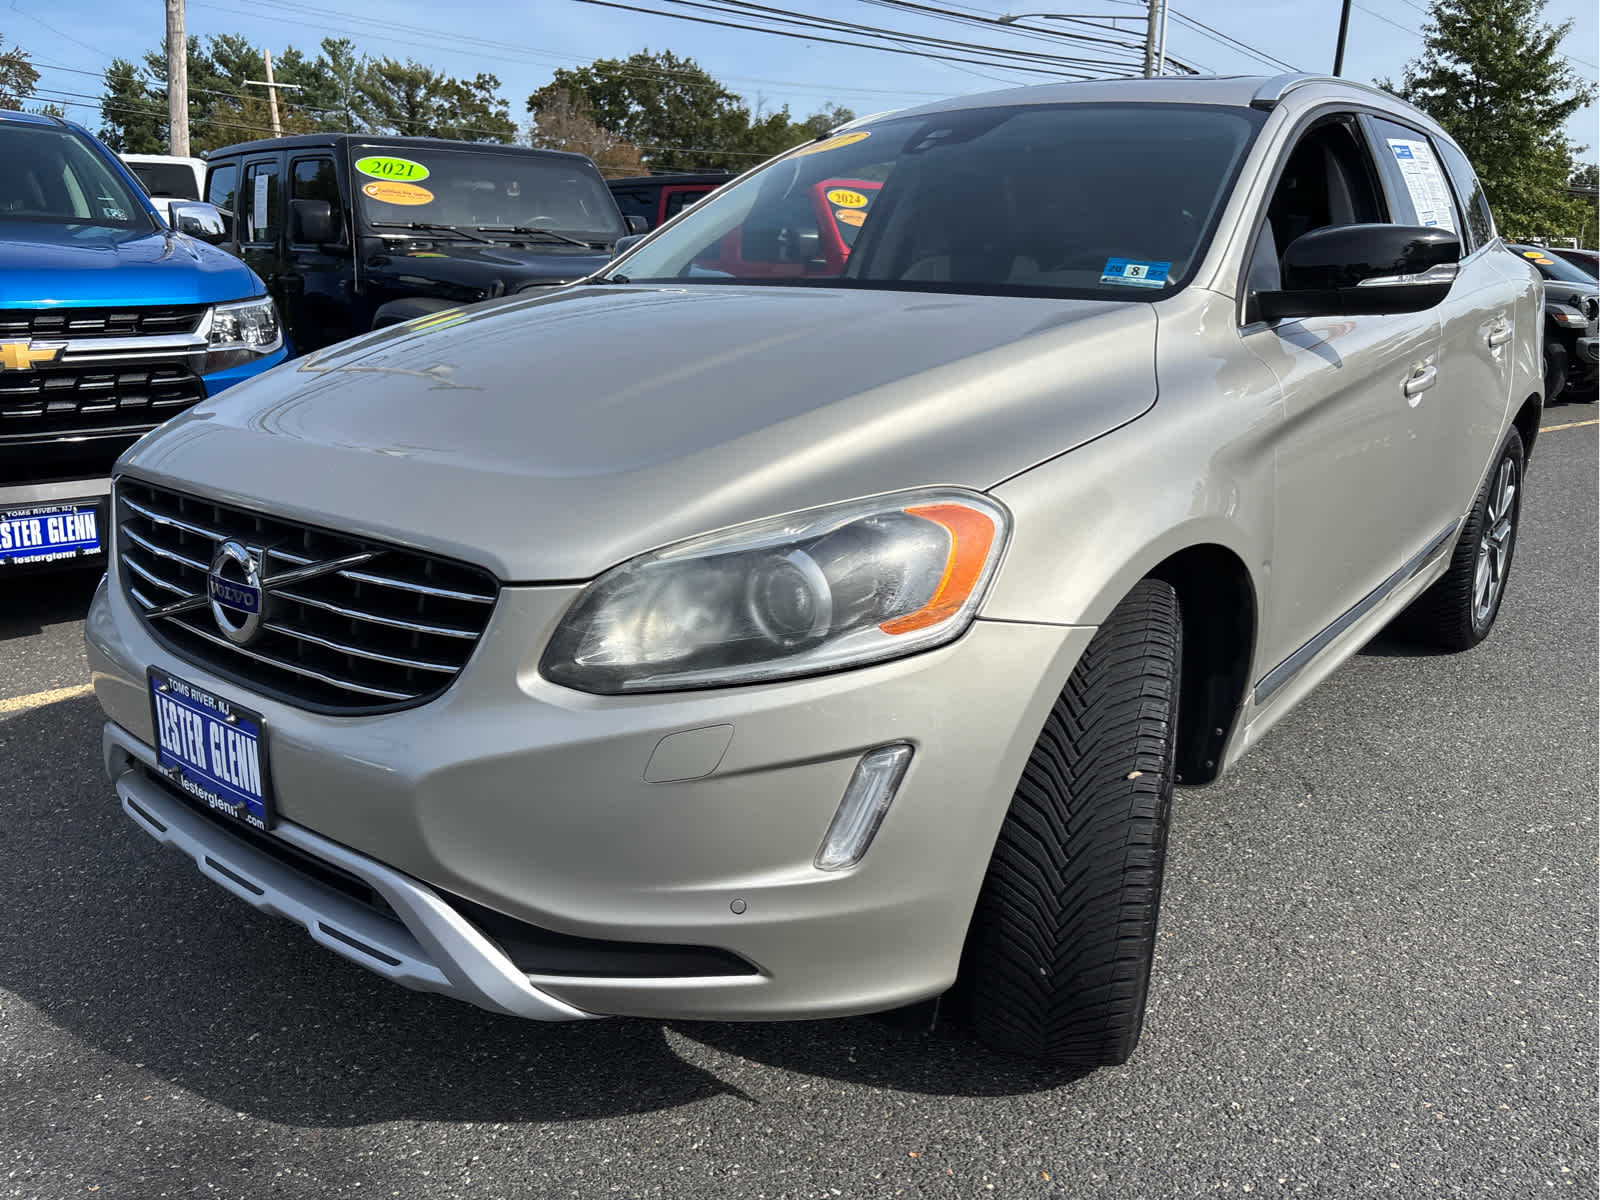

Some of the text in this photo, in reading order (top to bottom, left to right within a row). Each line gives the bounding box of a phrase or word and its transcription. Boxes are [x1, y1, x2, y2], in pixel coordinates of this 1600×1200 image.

[370, 161, 415, 176] 2021
[834, 193, 861, 204] 2024
[1130, 266, 1141, 276] 8
[6, 510, 31, 518] TOMS
[62, 504, 73, 512] NJ
[0, 513, 97, 549] STER GLENN
[210, 580, 255, 606] VOLVO
[168, 677, 230, 715] TOMS RIVER, NJ
[154, 692, 262, 797] LESTER GLENN
